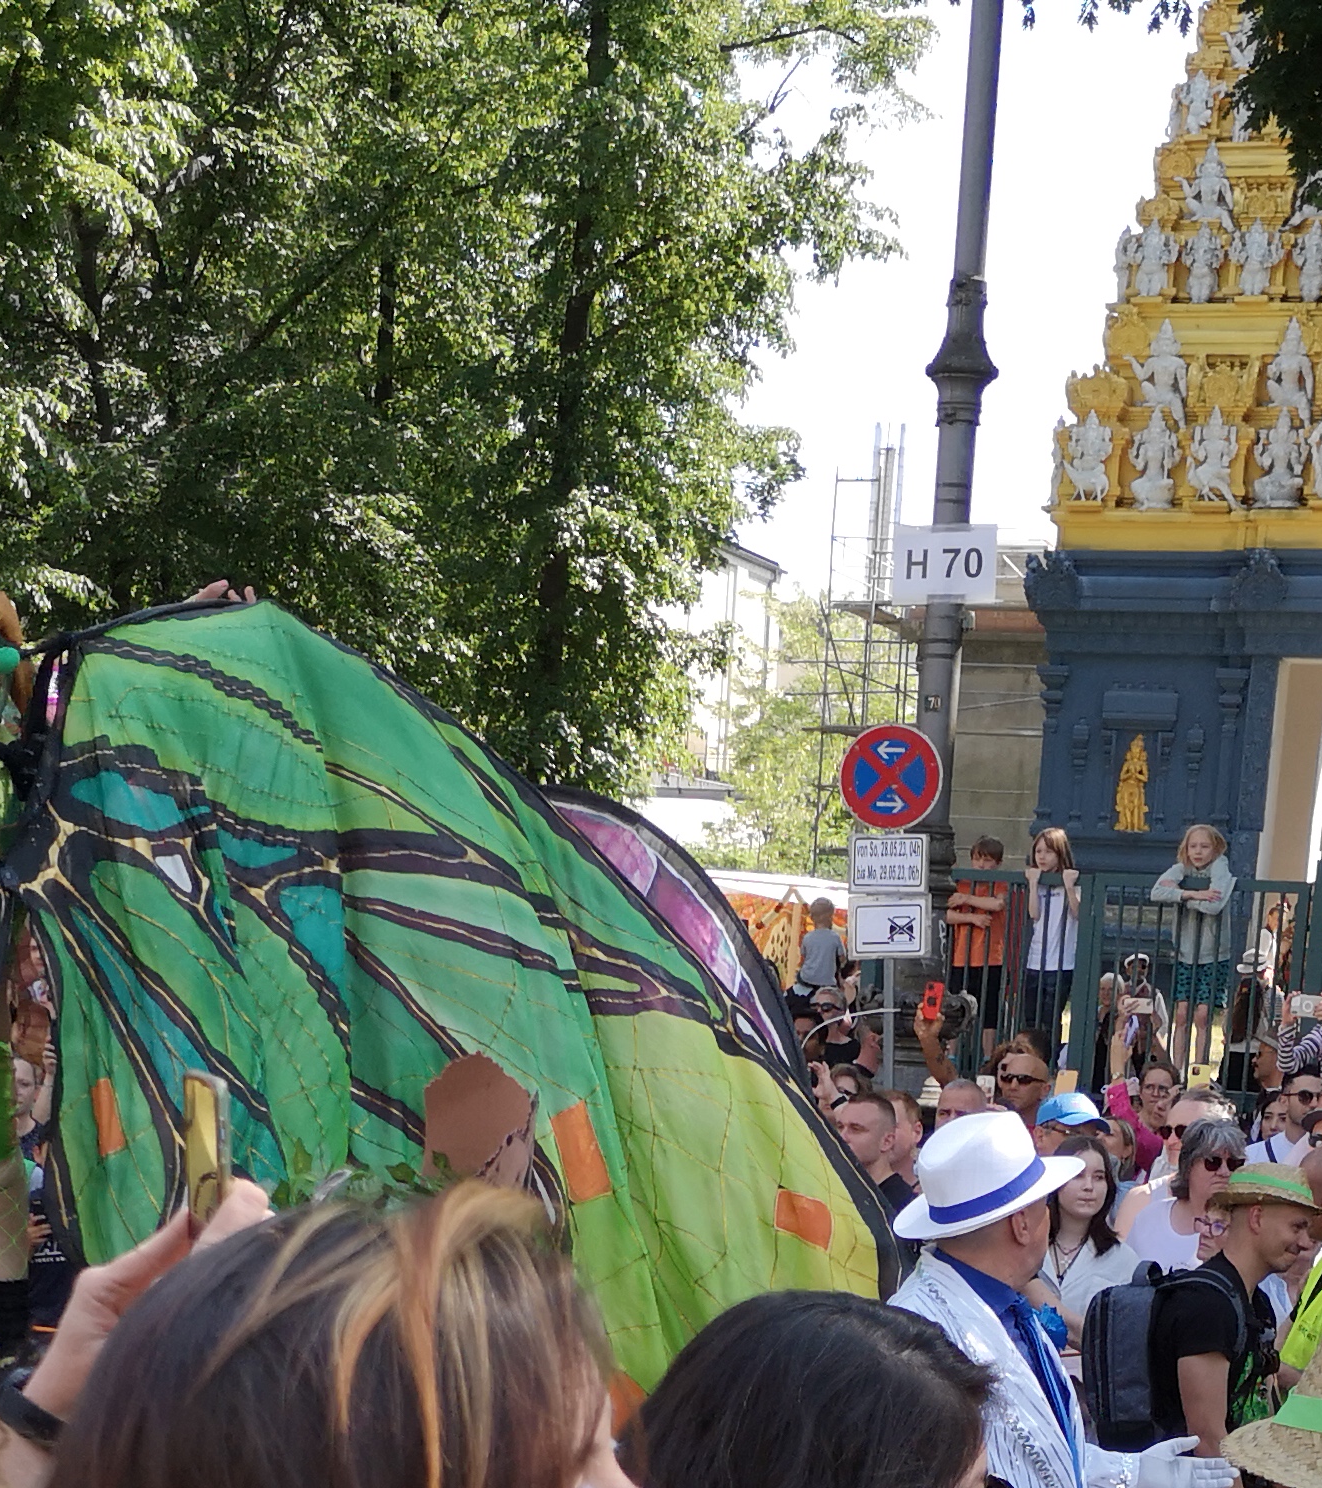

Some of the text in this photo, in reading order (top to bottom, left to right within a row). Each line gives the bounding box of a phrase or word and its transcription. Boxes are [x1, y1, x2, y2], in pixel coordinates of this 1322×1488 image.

[905, 548, 983, 580] H 70
[927, 695, 941, 709] 70
[857, 845, 868, 858] von
[857, 865, 865, 880] bis
